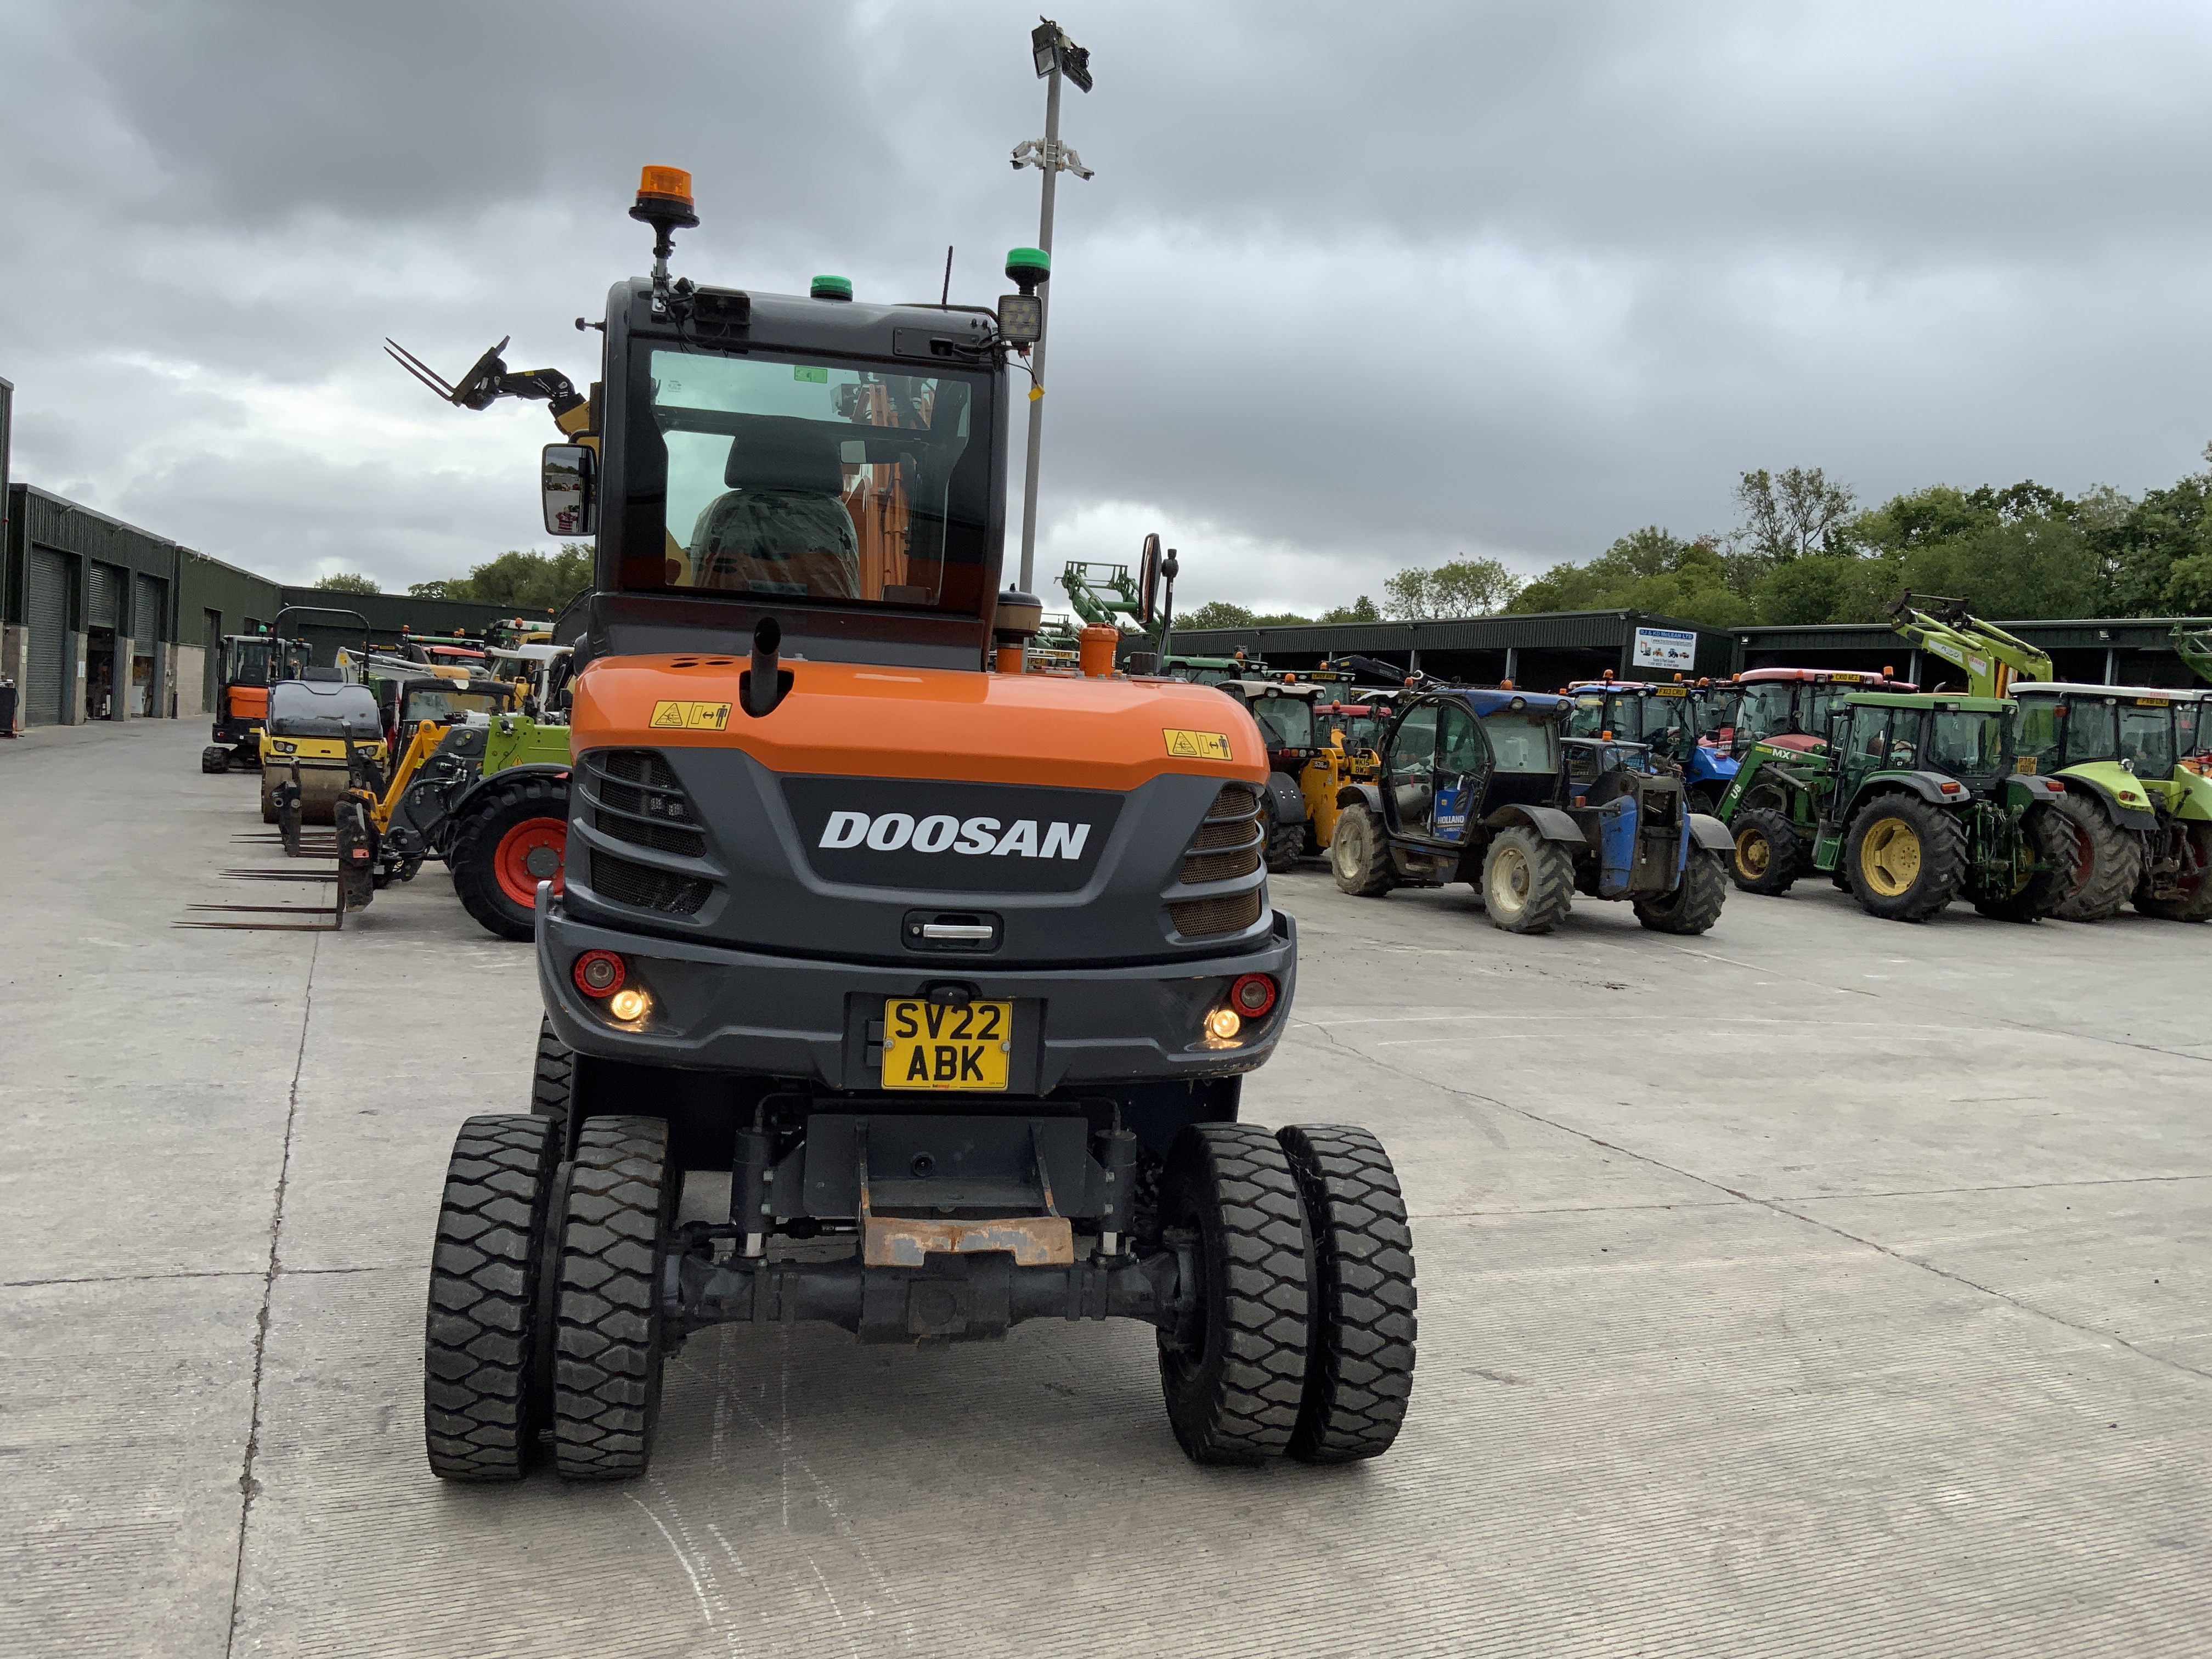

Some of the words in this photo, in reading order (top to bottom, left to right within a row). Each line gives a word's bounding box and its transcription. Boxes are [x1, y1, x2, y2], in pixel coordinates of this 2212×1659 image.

[1772, 748, 1791, 760] MX
[1730, 783, 1741, 799] U8
[1437, 815, 1465, 824] HOLLAND
[819, 811, 1091, 860] DOOSAN
[895, 1003, 1001, 1040] SV22
[906, 1045, 985, 1081] ABK
